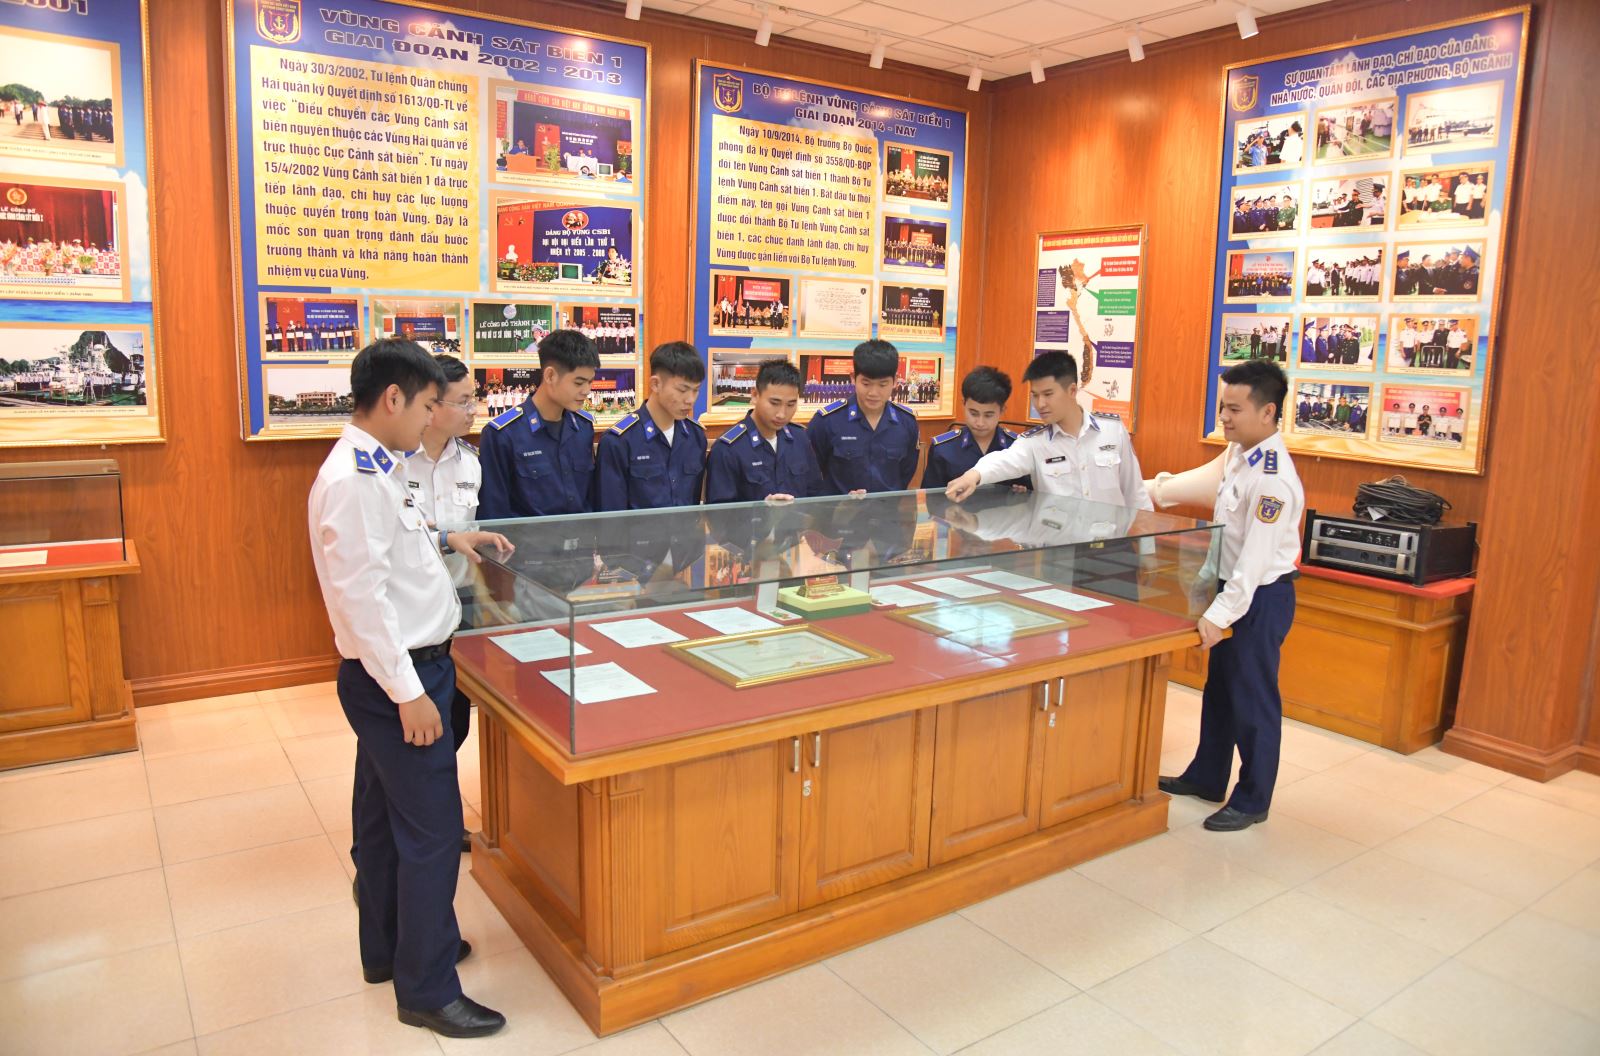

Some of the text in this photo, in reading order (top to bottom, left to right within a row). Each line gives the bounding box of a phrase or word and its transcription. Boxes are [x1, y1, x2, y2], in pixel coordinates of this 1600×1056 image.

[319, 8, 400, 33] VÙNG
[491, 36, 541, 55] SÁT
[611, 56, 622, 68] 1
[324, 29, 384, 49] GIAI
[393, 39, 469, 61] ĐOẠN
[477, 53, 540, 72] 2002
[564, 66, 622, 85] 2013
[1285, 70, 1298, 87] SỰ
[1299, 68, 1322, 83] QUAN
[1373, 53, 1394, 70] ĐẠO,
[1397, 45, 1414, 65] CHỈ
[1417, 46, 1437, 64] ĐẠO
[1440, 38, 1461, 58] CỦA
[1271, 89, 1289, 105] NHÀ
[1319, 82, 1343, 98] QUÂN
[1366, 74, 1385, 89] CÁC
[1388, 73, 1404, 89] ĐỊA
[1406, 64, 1451, 83] PHƯƠNG,
[1455, 57, 1469, 78] BỘ
[1472, 53, 1512, 71] NGÀNH
[752, 82, 770, 98] BỘ
[826, 94, 858, 111] VÙNG
[895, 108, 916, 121] SÁT
[917, 112, 942, 128] BIỂN
[945, 118, 951, 129] 1
[795, 106, 819, 121] GIAI
[822, 112, 855, 127] ĐOẠN
[857, 118, 886, 132] 2014
[894, 124, 917, 137] NAY
[264, 161, 319, 176] 15/4/2002
